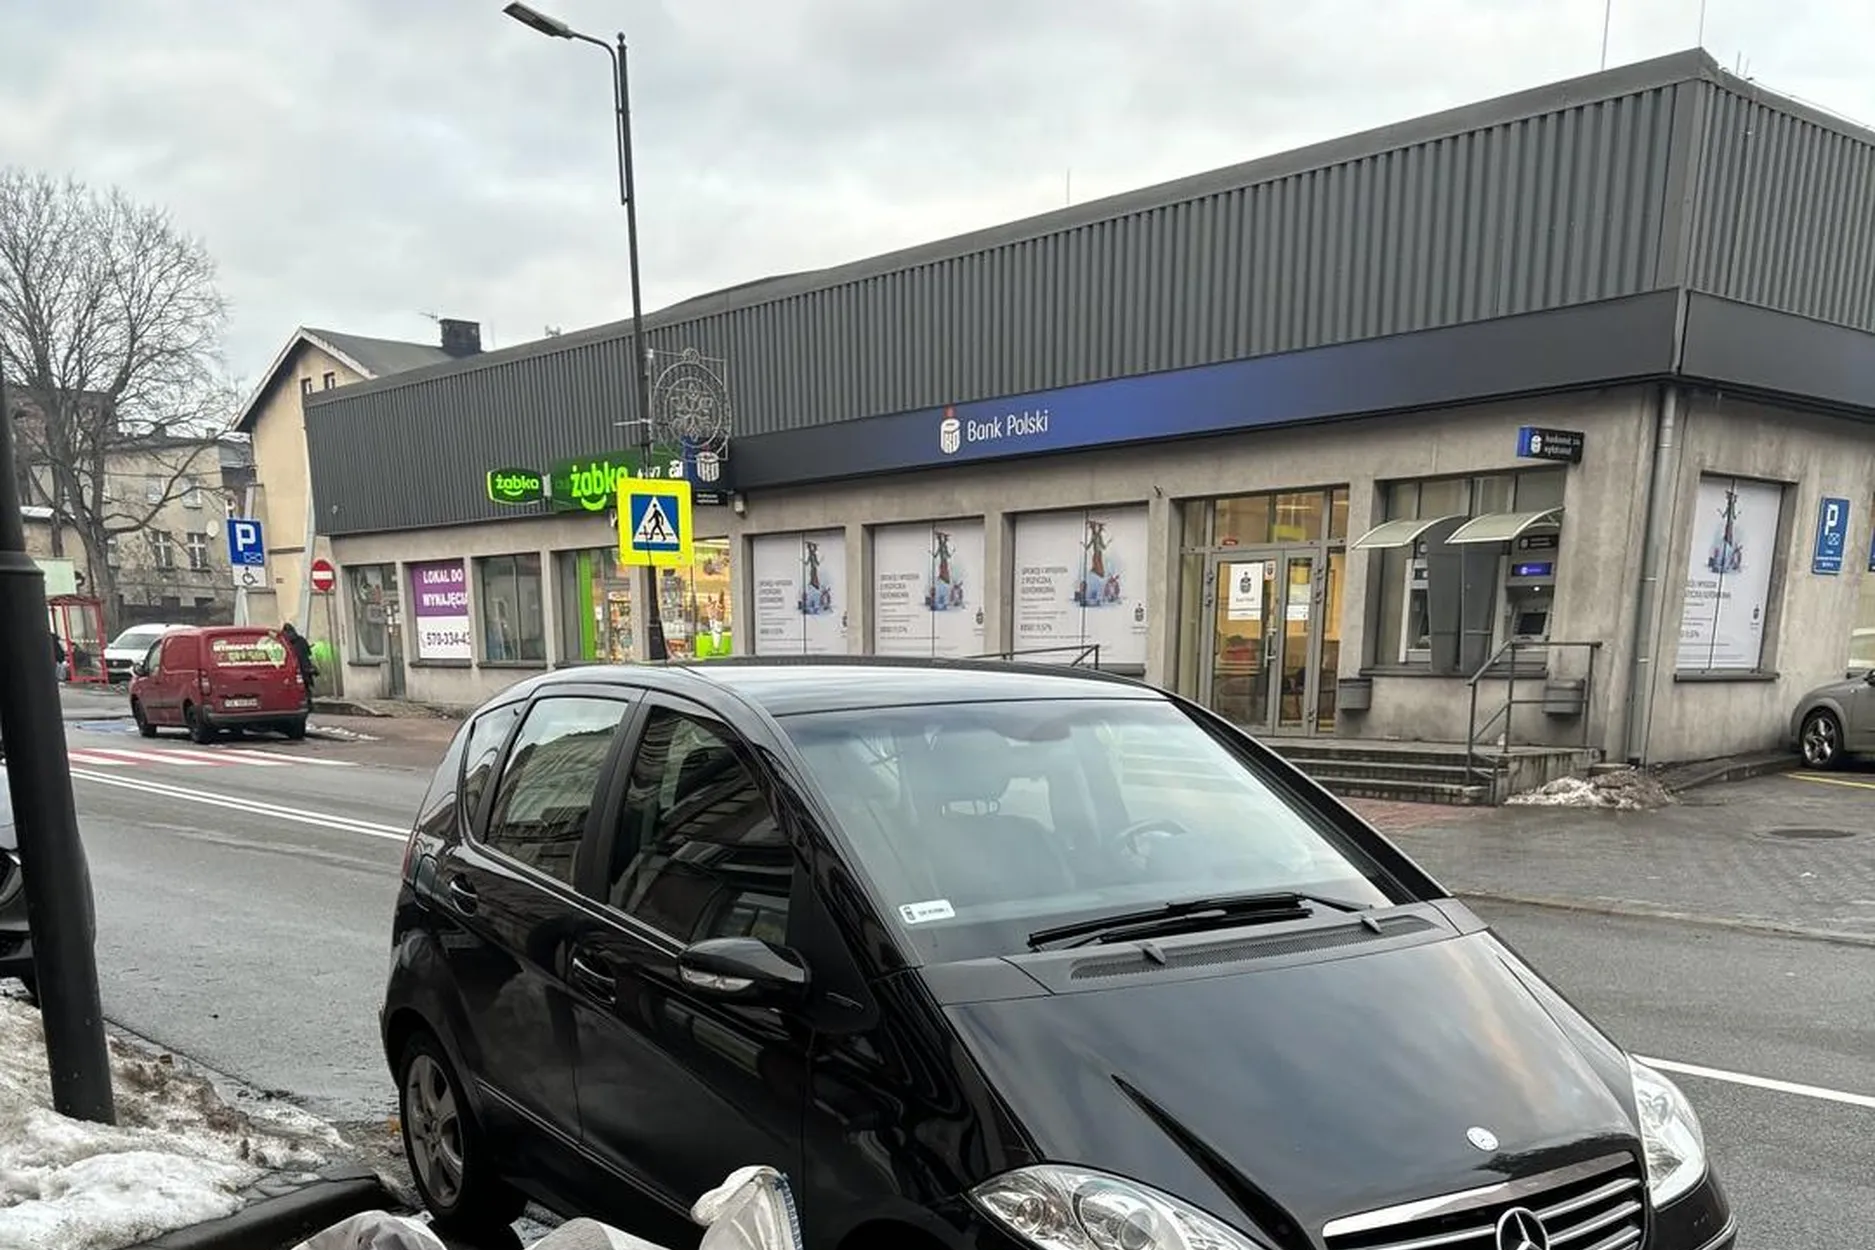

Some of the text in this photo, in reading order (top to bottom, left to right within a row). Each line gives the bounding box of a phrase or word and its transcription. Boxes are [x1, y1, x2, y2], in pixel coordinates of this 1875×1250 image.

[967, 416, 1002, 442] Bank
[1006, 409, 1049, 436] Polski
[495, 474, 540, 489] żabka
[1824, 504, 1840, 536] P
[235, 523, 256, 552] P
[422, 568, 463, 584] LOKAL DO
